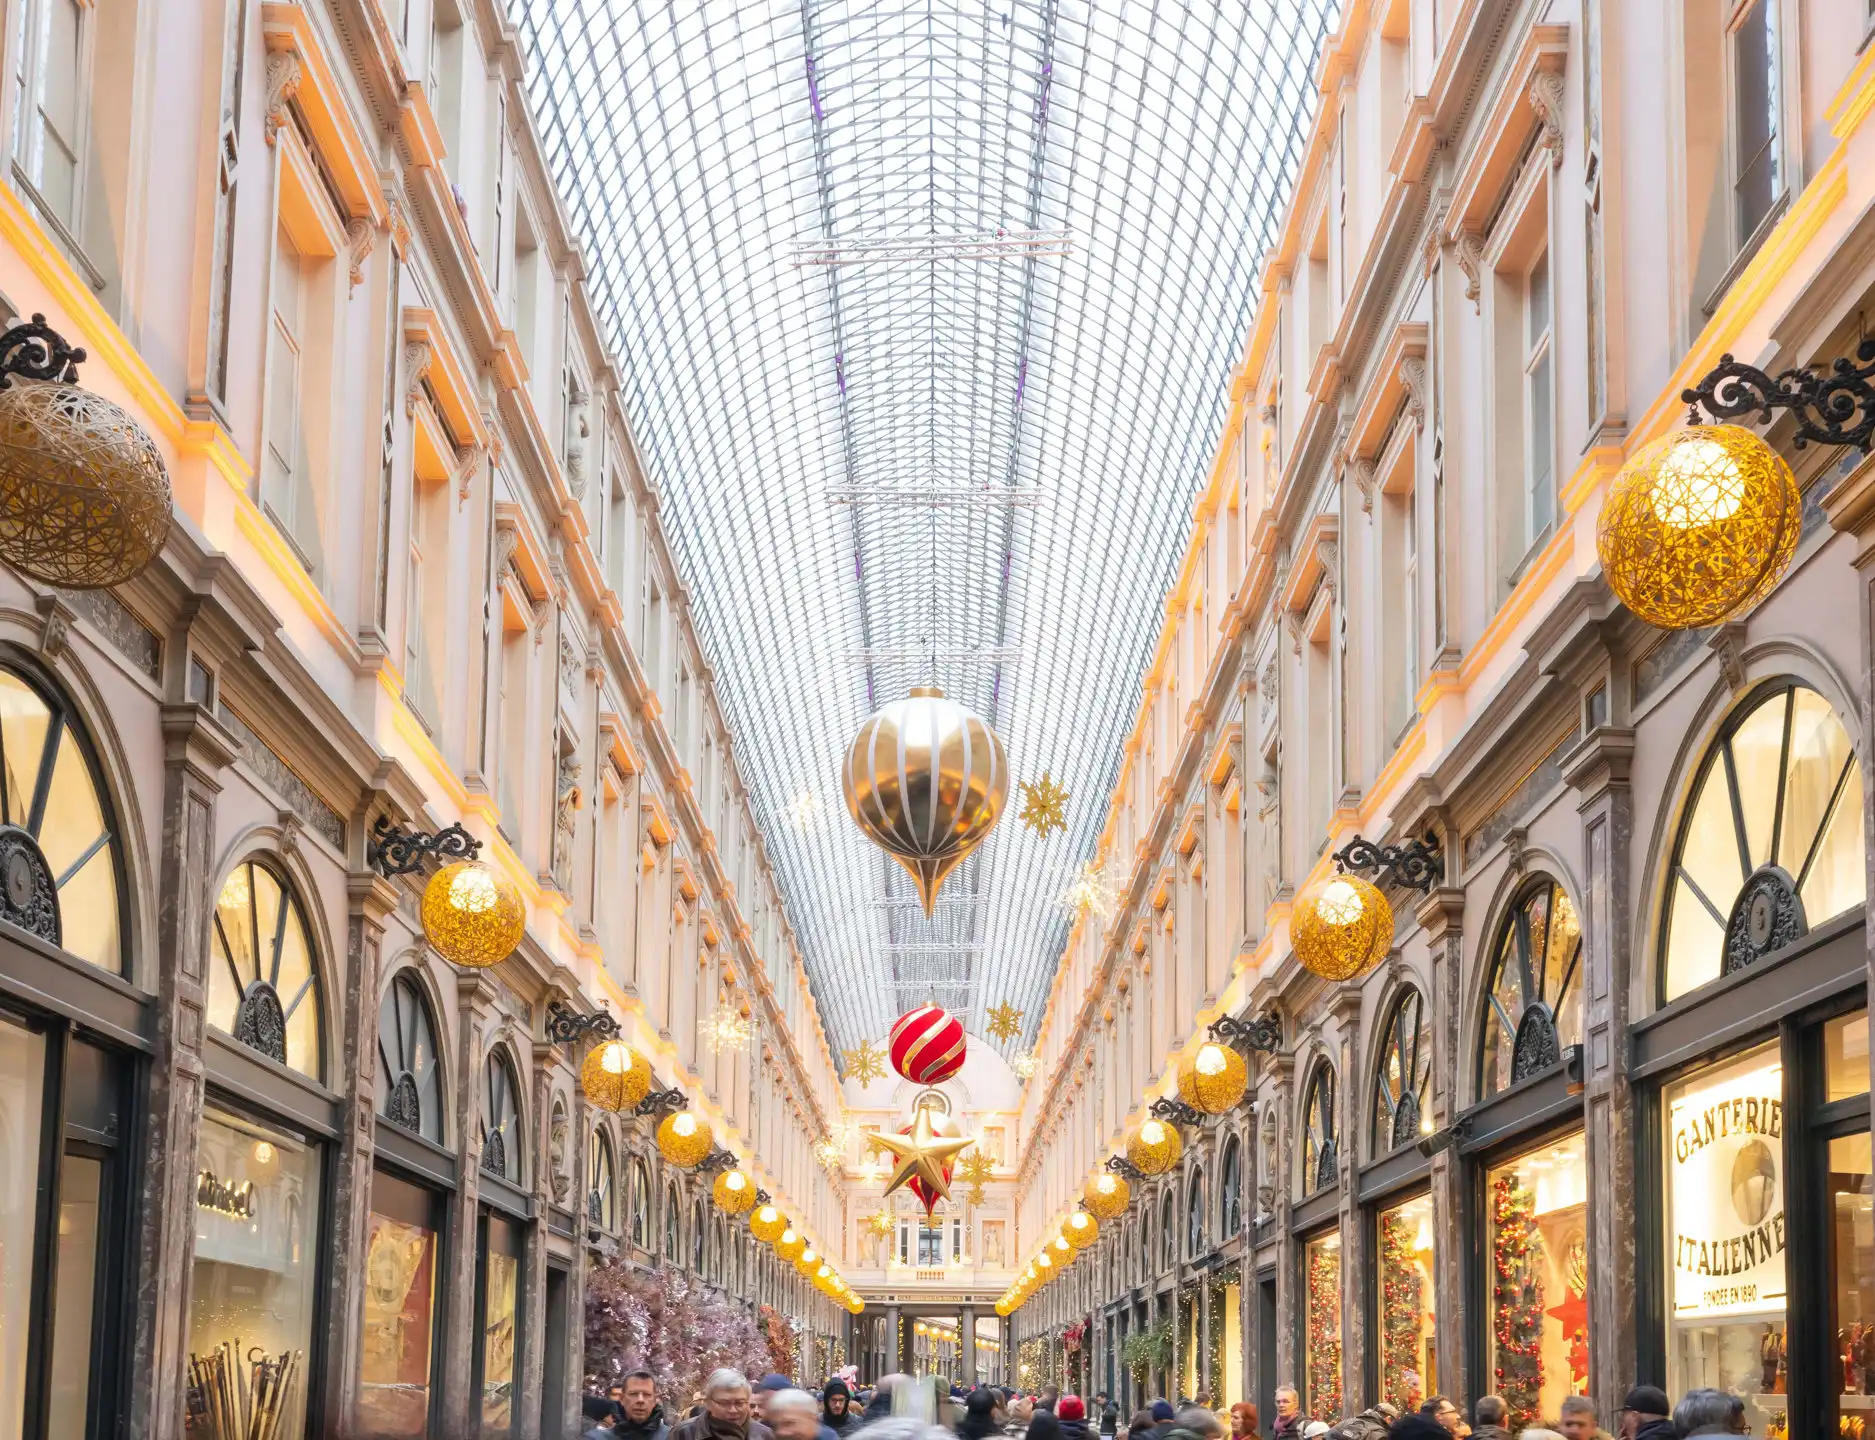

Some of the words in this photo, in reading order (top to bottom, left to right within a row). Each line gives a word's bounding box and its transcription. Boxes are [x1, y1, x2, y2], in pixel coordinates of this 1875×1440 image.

[1676, 1096, 1782, 1164] GANTERIE
[1676, 1210, 1785, 1276] ITALIENNE
[1730, 1284, 1739, 1304] EN
